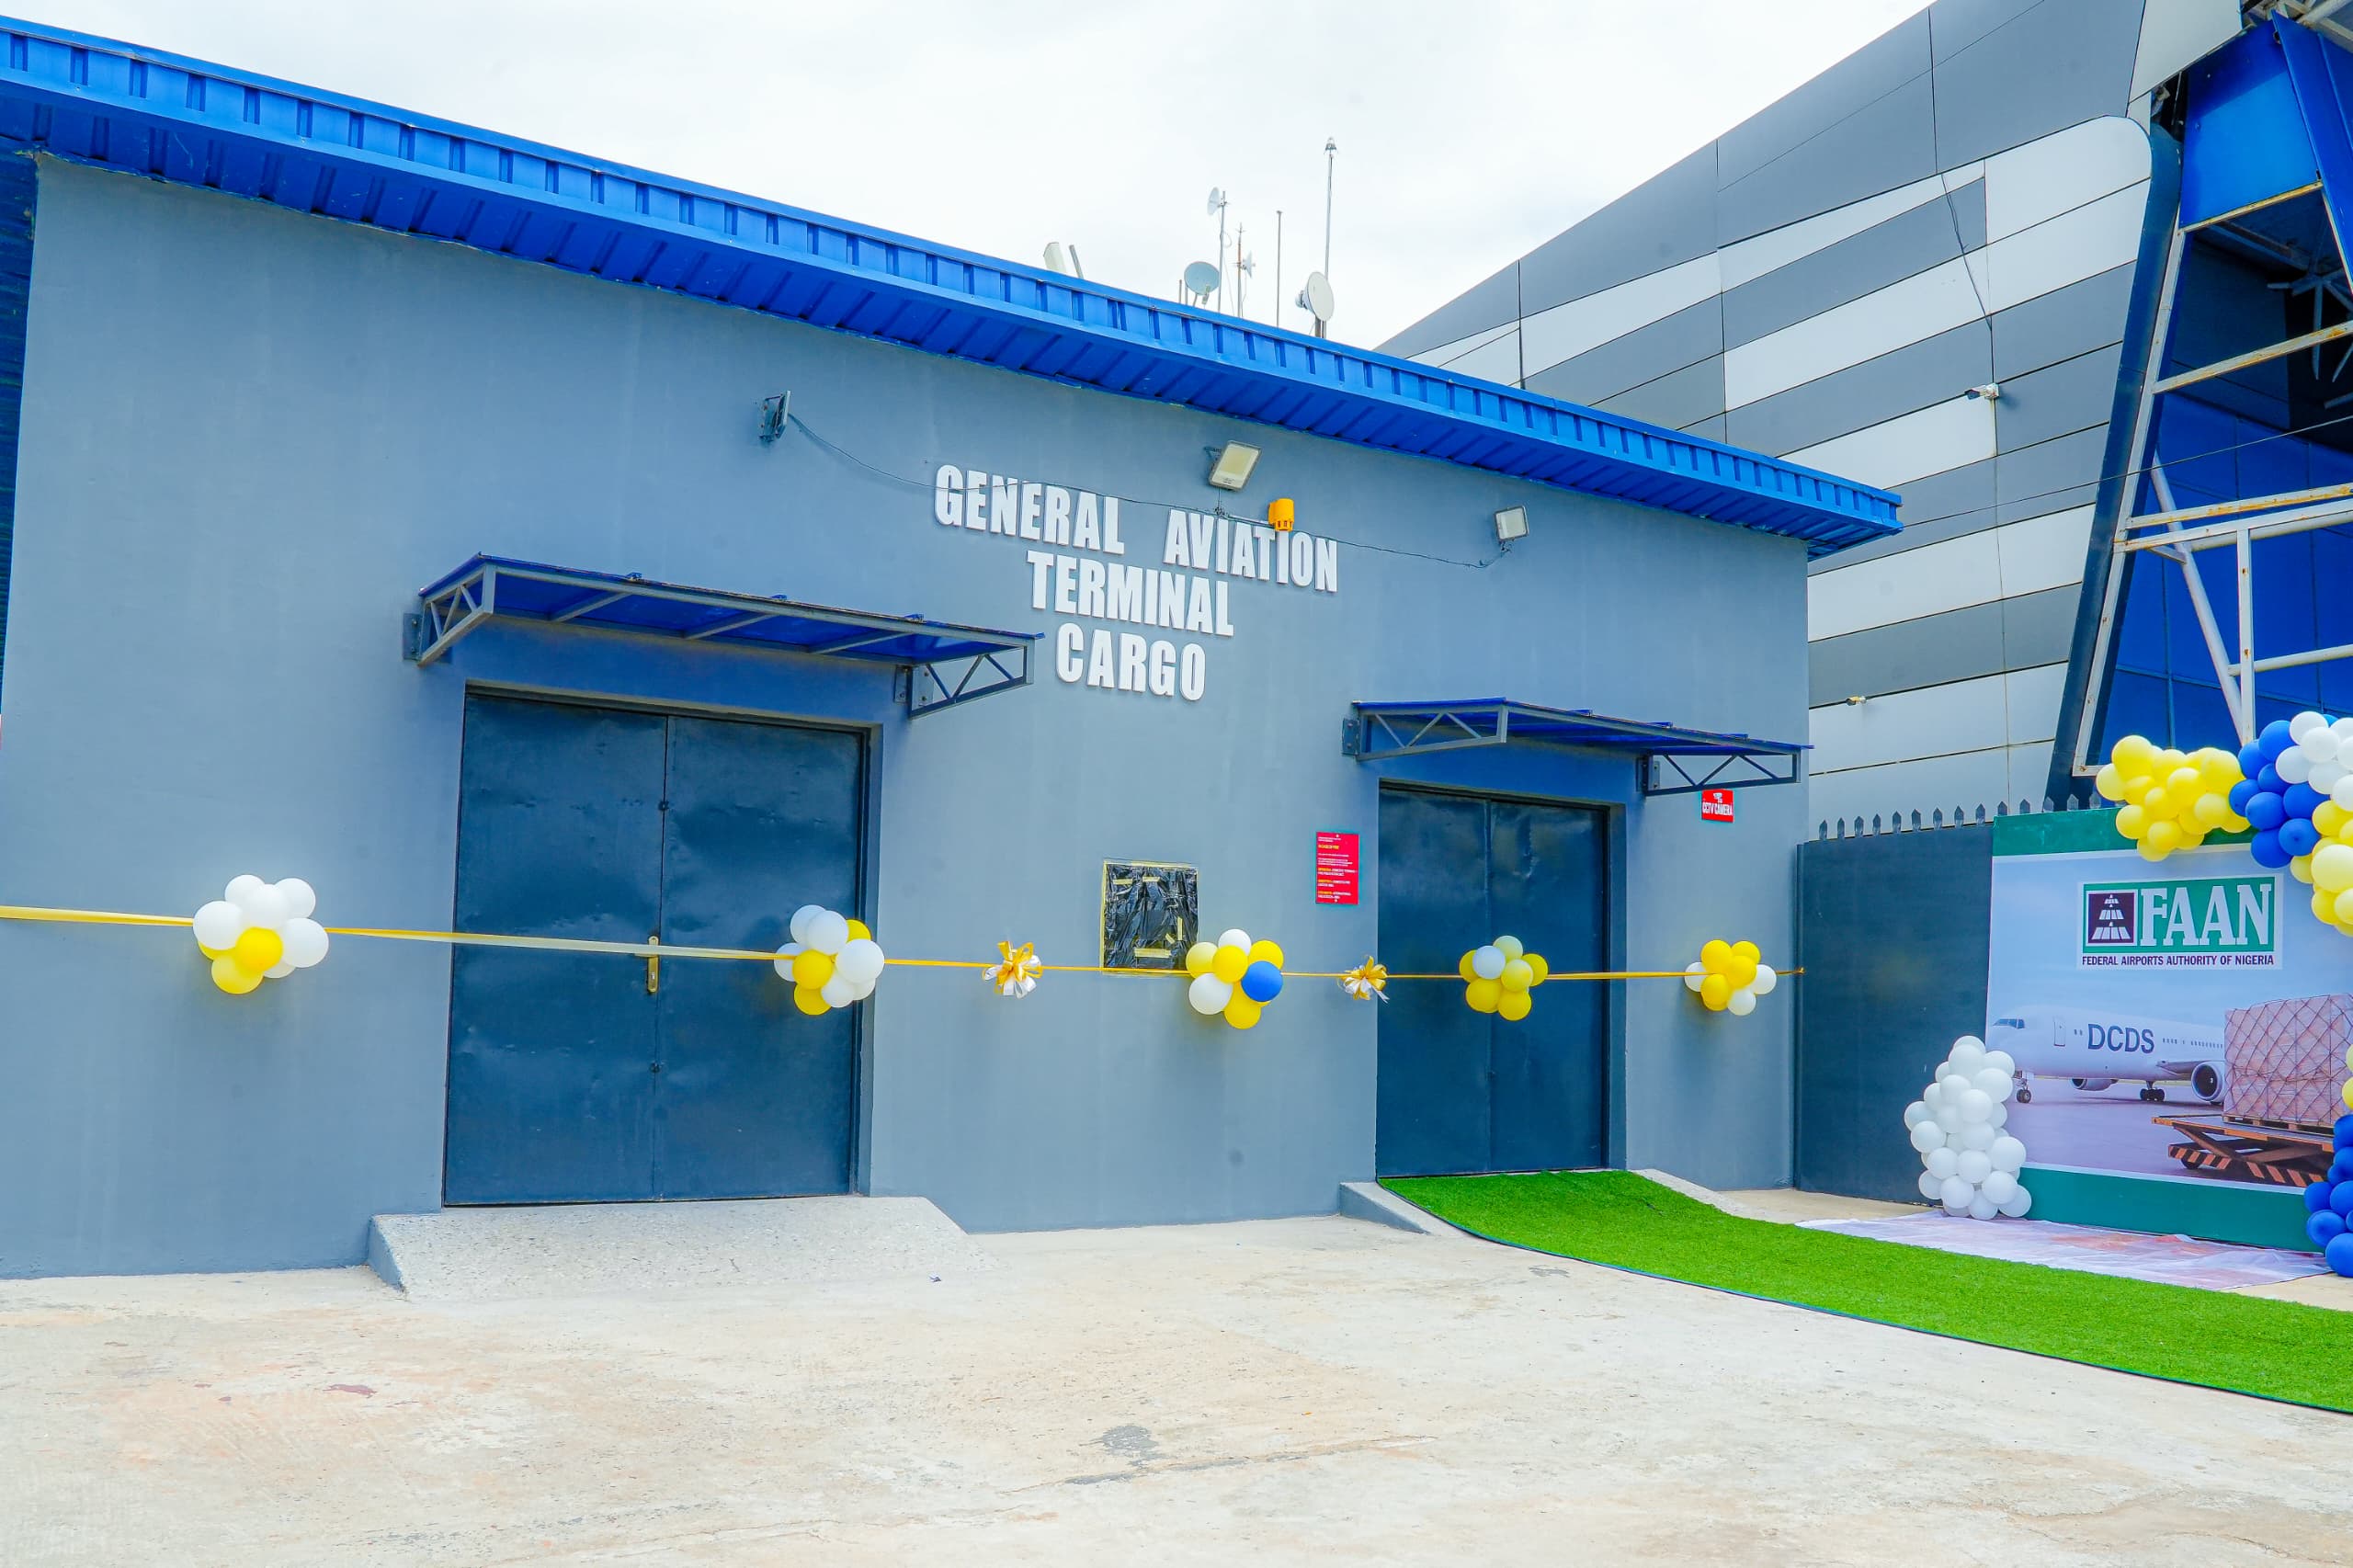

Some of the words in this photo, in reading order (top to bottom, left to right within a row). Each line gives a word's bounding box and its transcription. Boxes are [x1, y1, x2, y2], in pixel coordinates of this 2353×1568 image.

[935, 464, 1124, 555] GENERAL
[1163, 509, 1337, 592] AVIATION
[1026, 551, 1233, 636] TERMINAL
[1056, 623, 1206, 701] CARGO
[2140, 883, 2272, 946] FAAN
[2082, 956, 2118, 966] FEDERAL
[2120, 955, 2164, 965] AIRPORTS
[2166, 955, 2218, 965] AUTHORITY
[2220, 955, 2233, 965] OF
[2234, 954, 2274, 965] NIGERIA
[2087, 1023, 2155, 1054] DCDS
